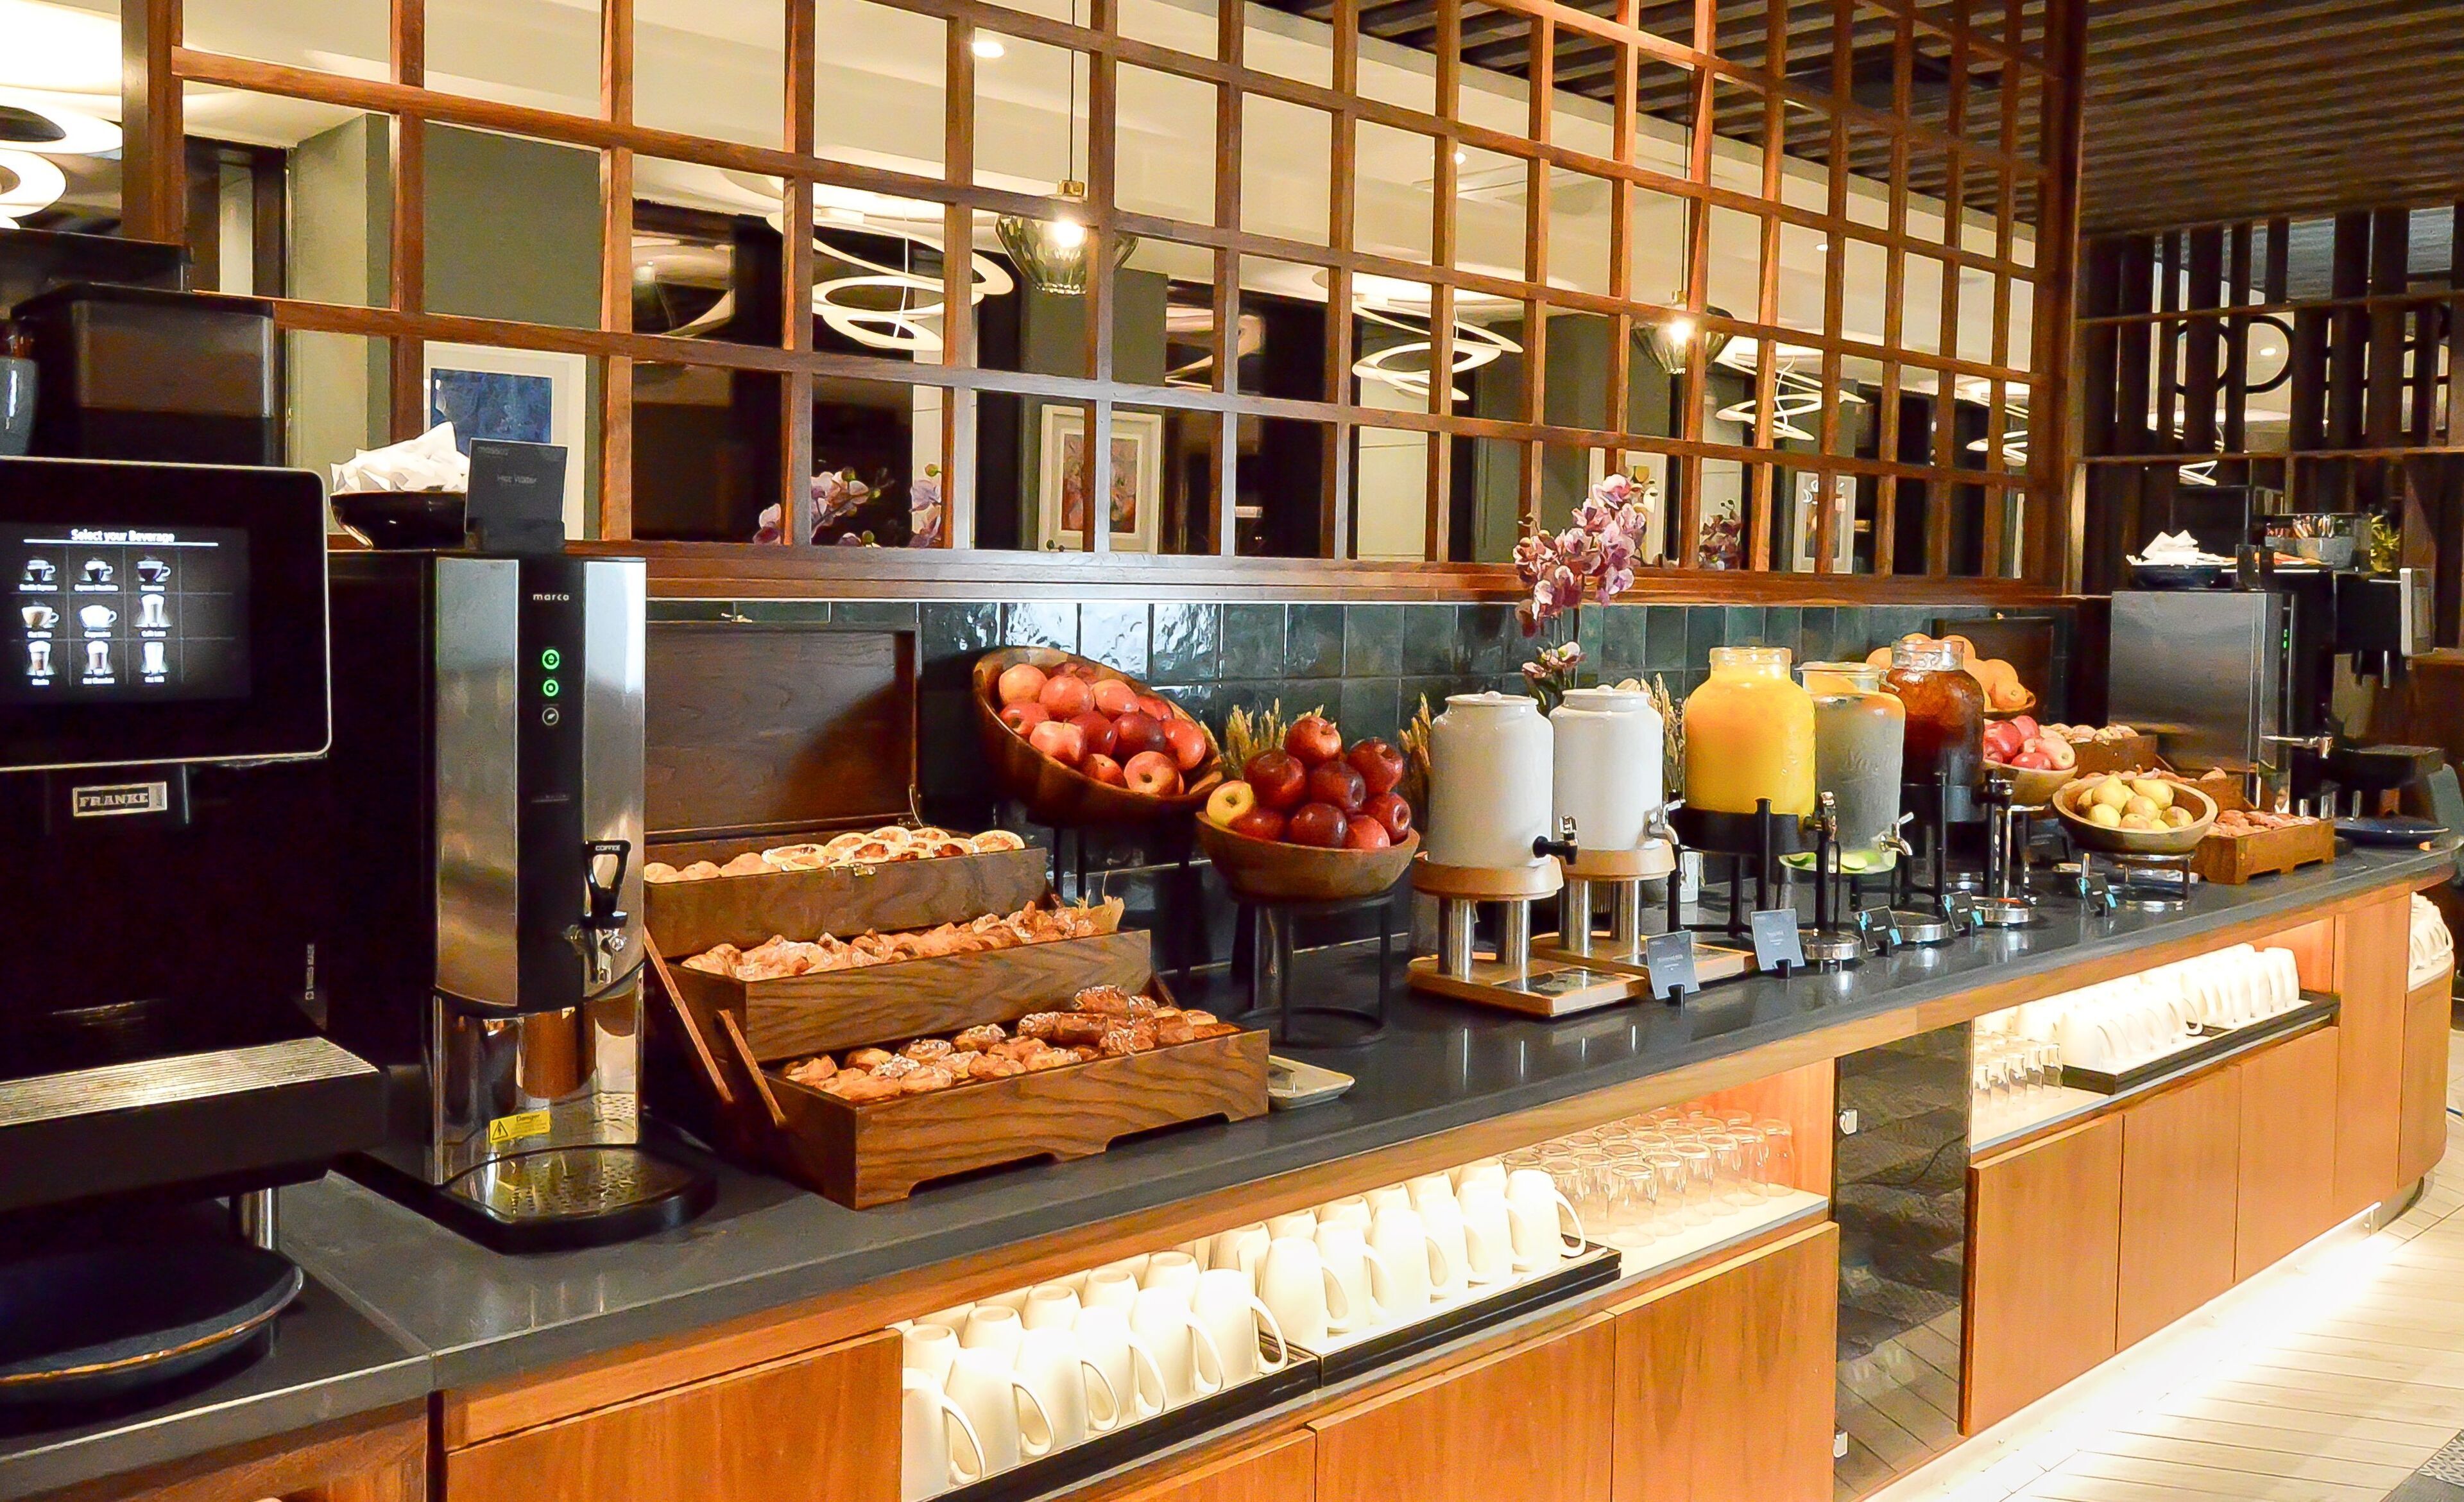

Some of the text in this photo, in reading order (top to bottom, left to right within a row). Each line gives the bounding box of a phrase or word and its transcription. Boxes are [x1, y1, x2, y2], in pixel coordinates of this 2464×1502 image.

[71, 529, 175, 543] Select your Beverage
[533, 593, 569, 601] marco
[80, 793, 148, 807] FRANKE
